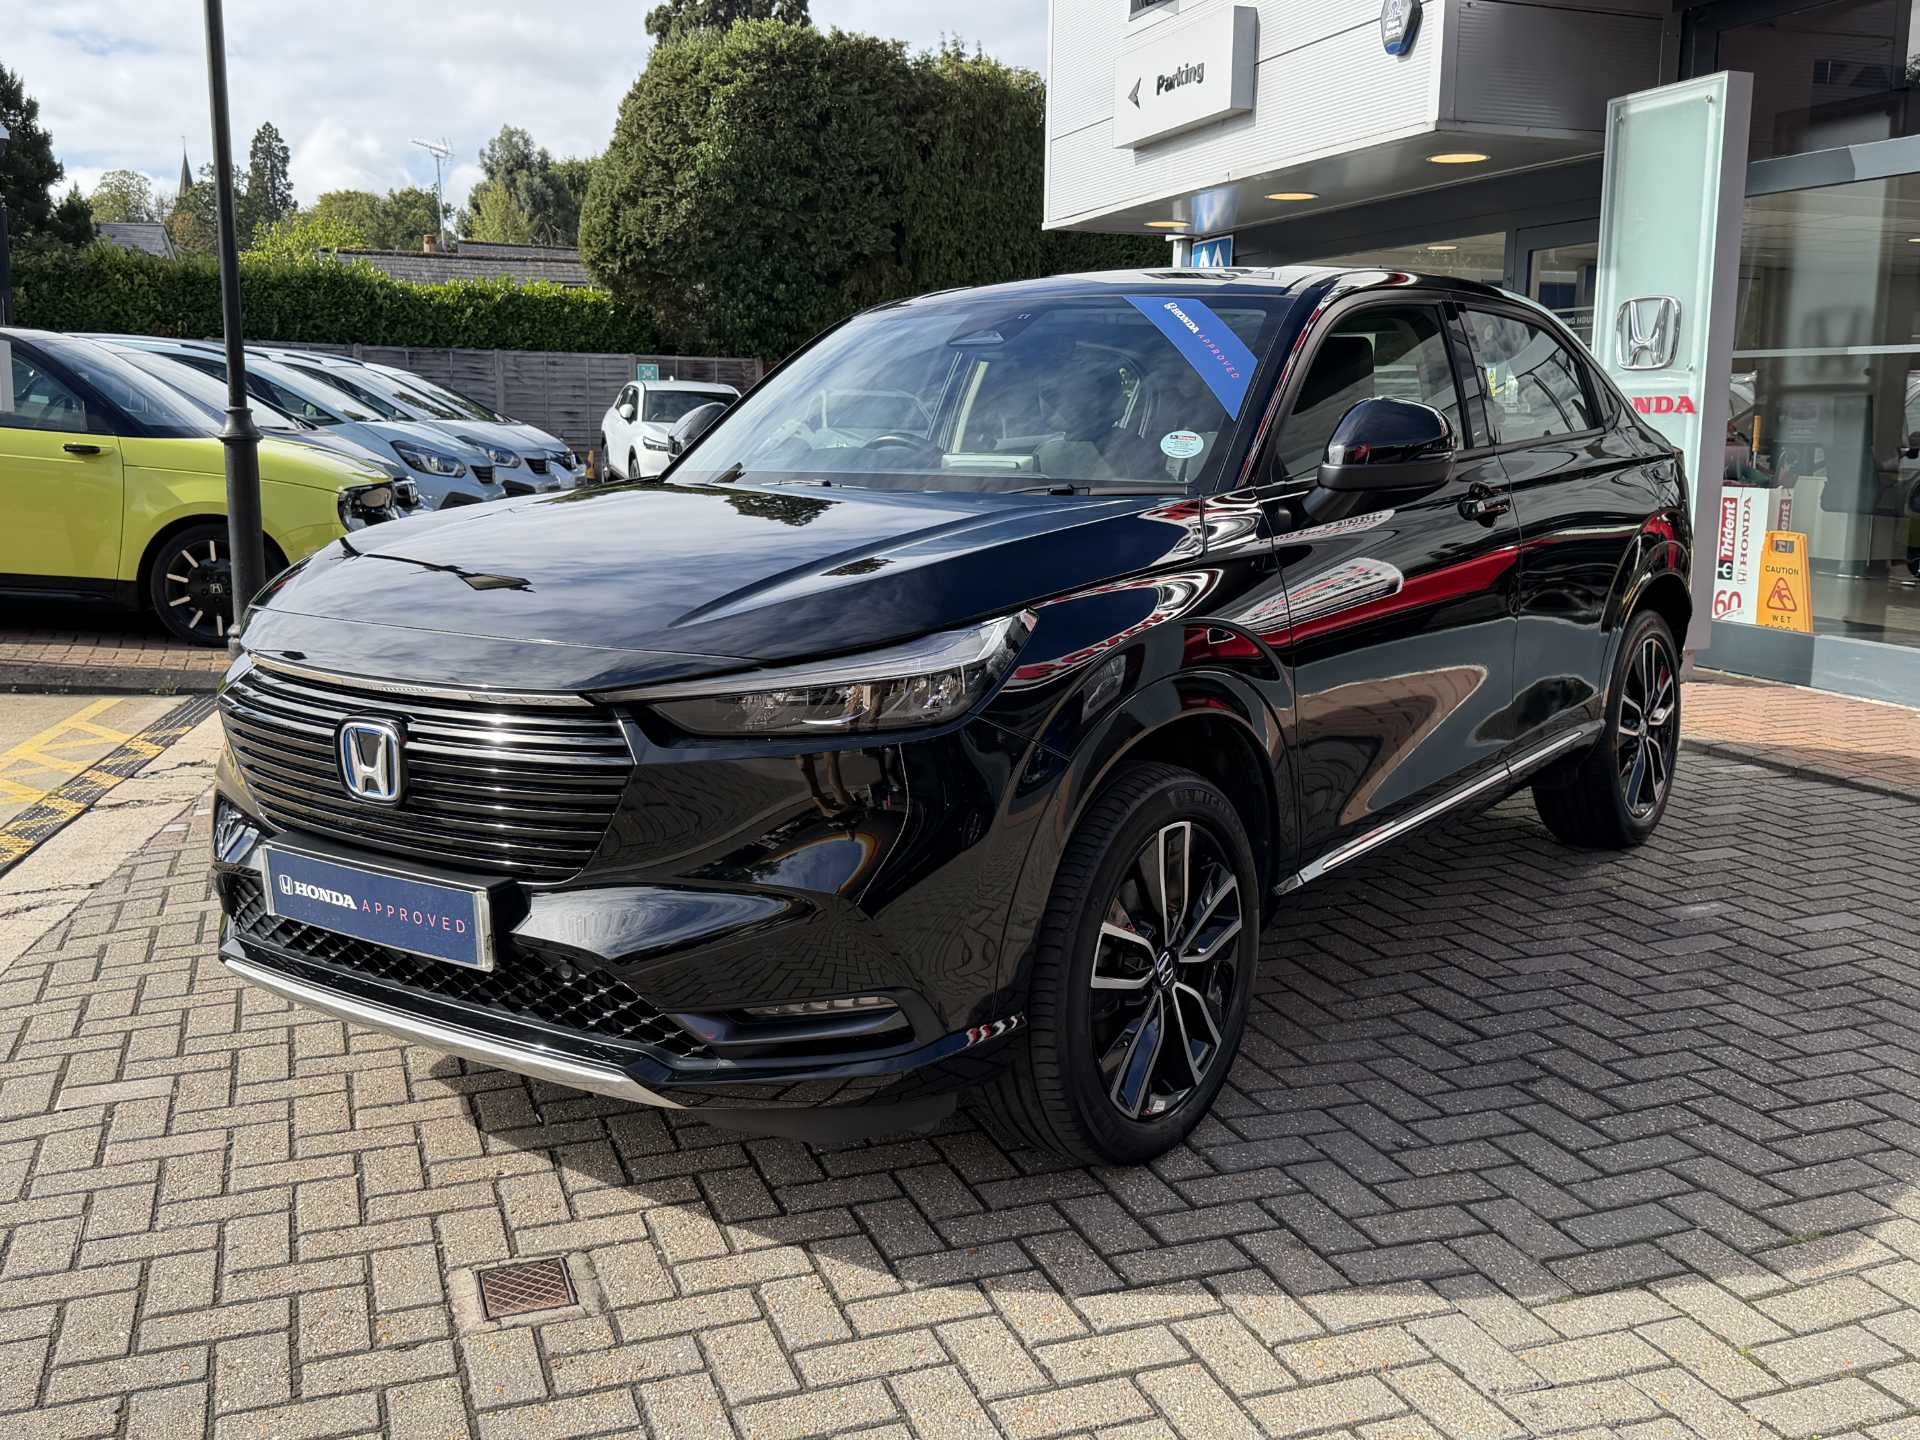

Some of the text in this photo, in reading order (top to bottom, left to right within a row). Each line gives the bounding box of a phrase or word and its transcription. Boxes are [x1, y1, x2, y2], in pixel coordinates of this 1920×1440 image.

[1156, 62, 1205, 96] Parking
[1171, 304, 1240, 379] HONDA APPROVED
[1631, 395, 1697, 414] NDA
[1720, 499, 1737, 558] Trident
[1740, 496, 1752, 565] HONDA
[1765, 564, 1799, 576] CAUTION
[1772, 614, 1792, 624] WET
[293, 880, 466, 934] HONDA APPROVED
